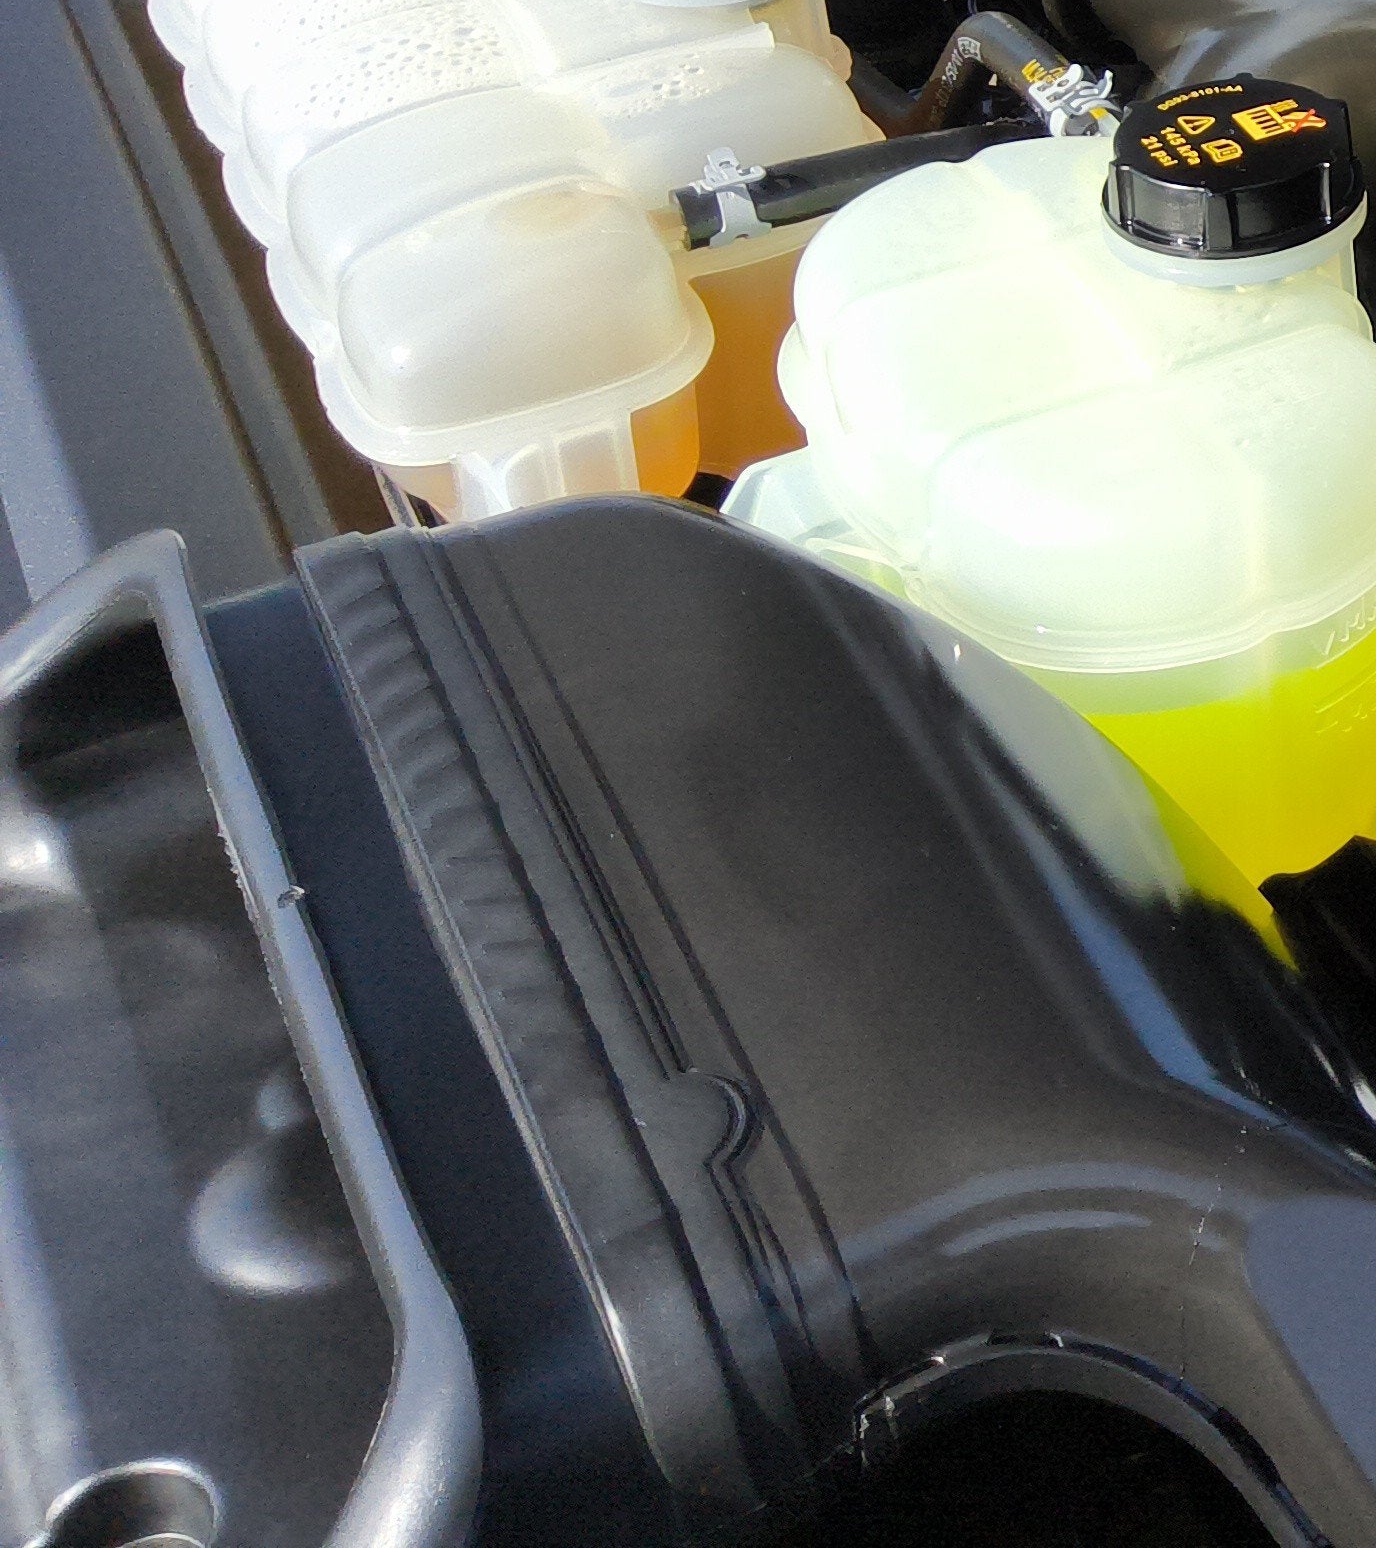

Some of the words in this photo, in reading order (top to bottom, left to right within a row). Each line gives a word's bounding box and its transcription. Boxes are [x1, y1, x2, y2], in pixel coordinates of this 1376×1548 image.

[1140, 135, 1165, 151] 21
[1160, 126, 1187, 146] 145
[1176, 144, 1202, 167] kPa
[1151, 149, 1180, 168] psi
